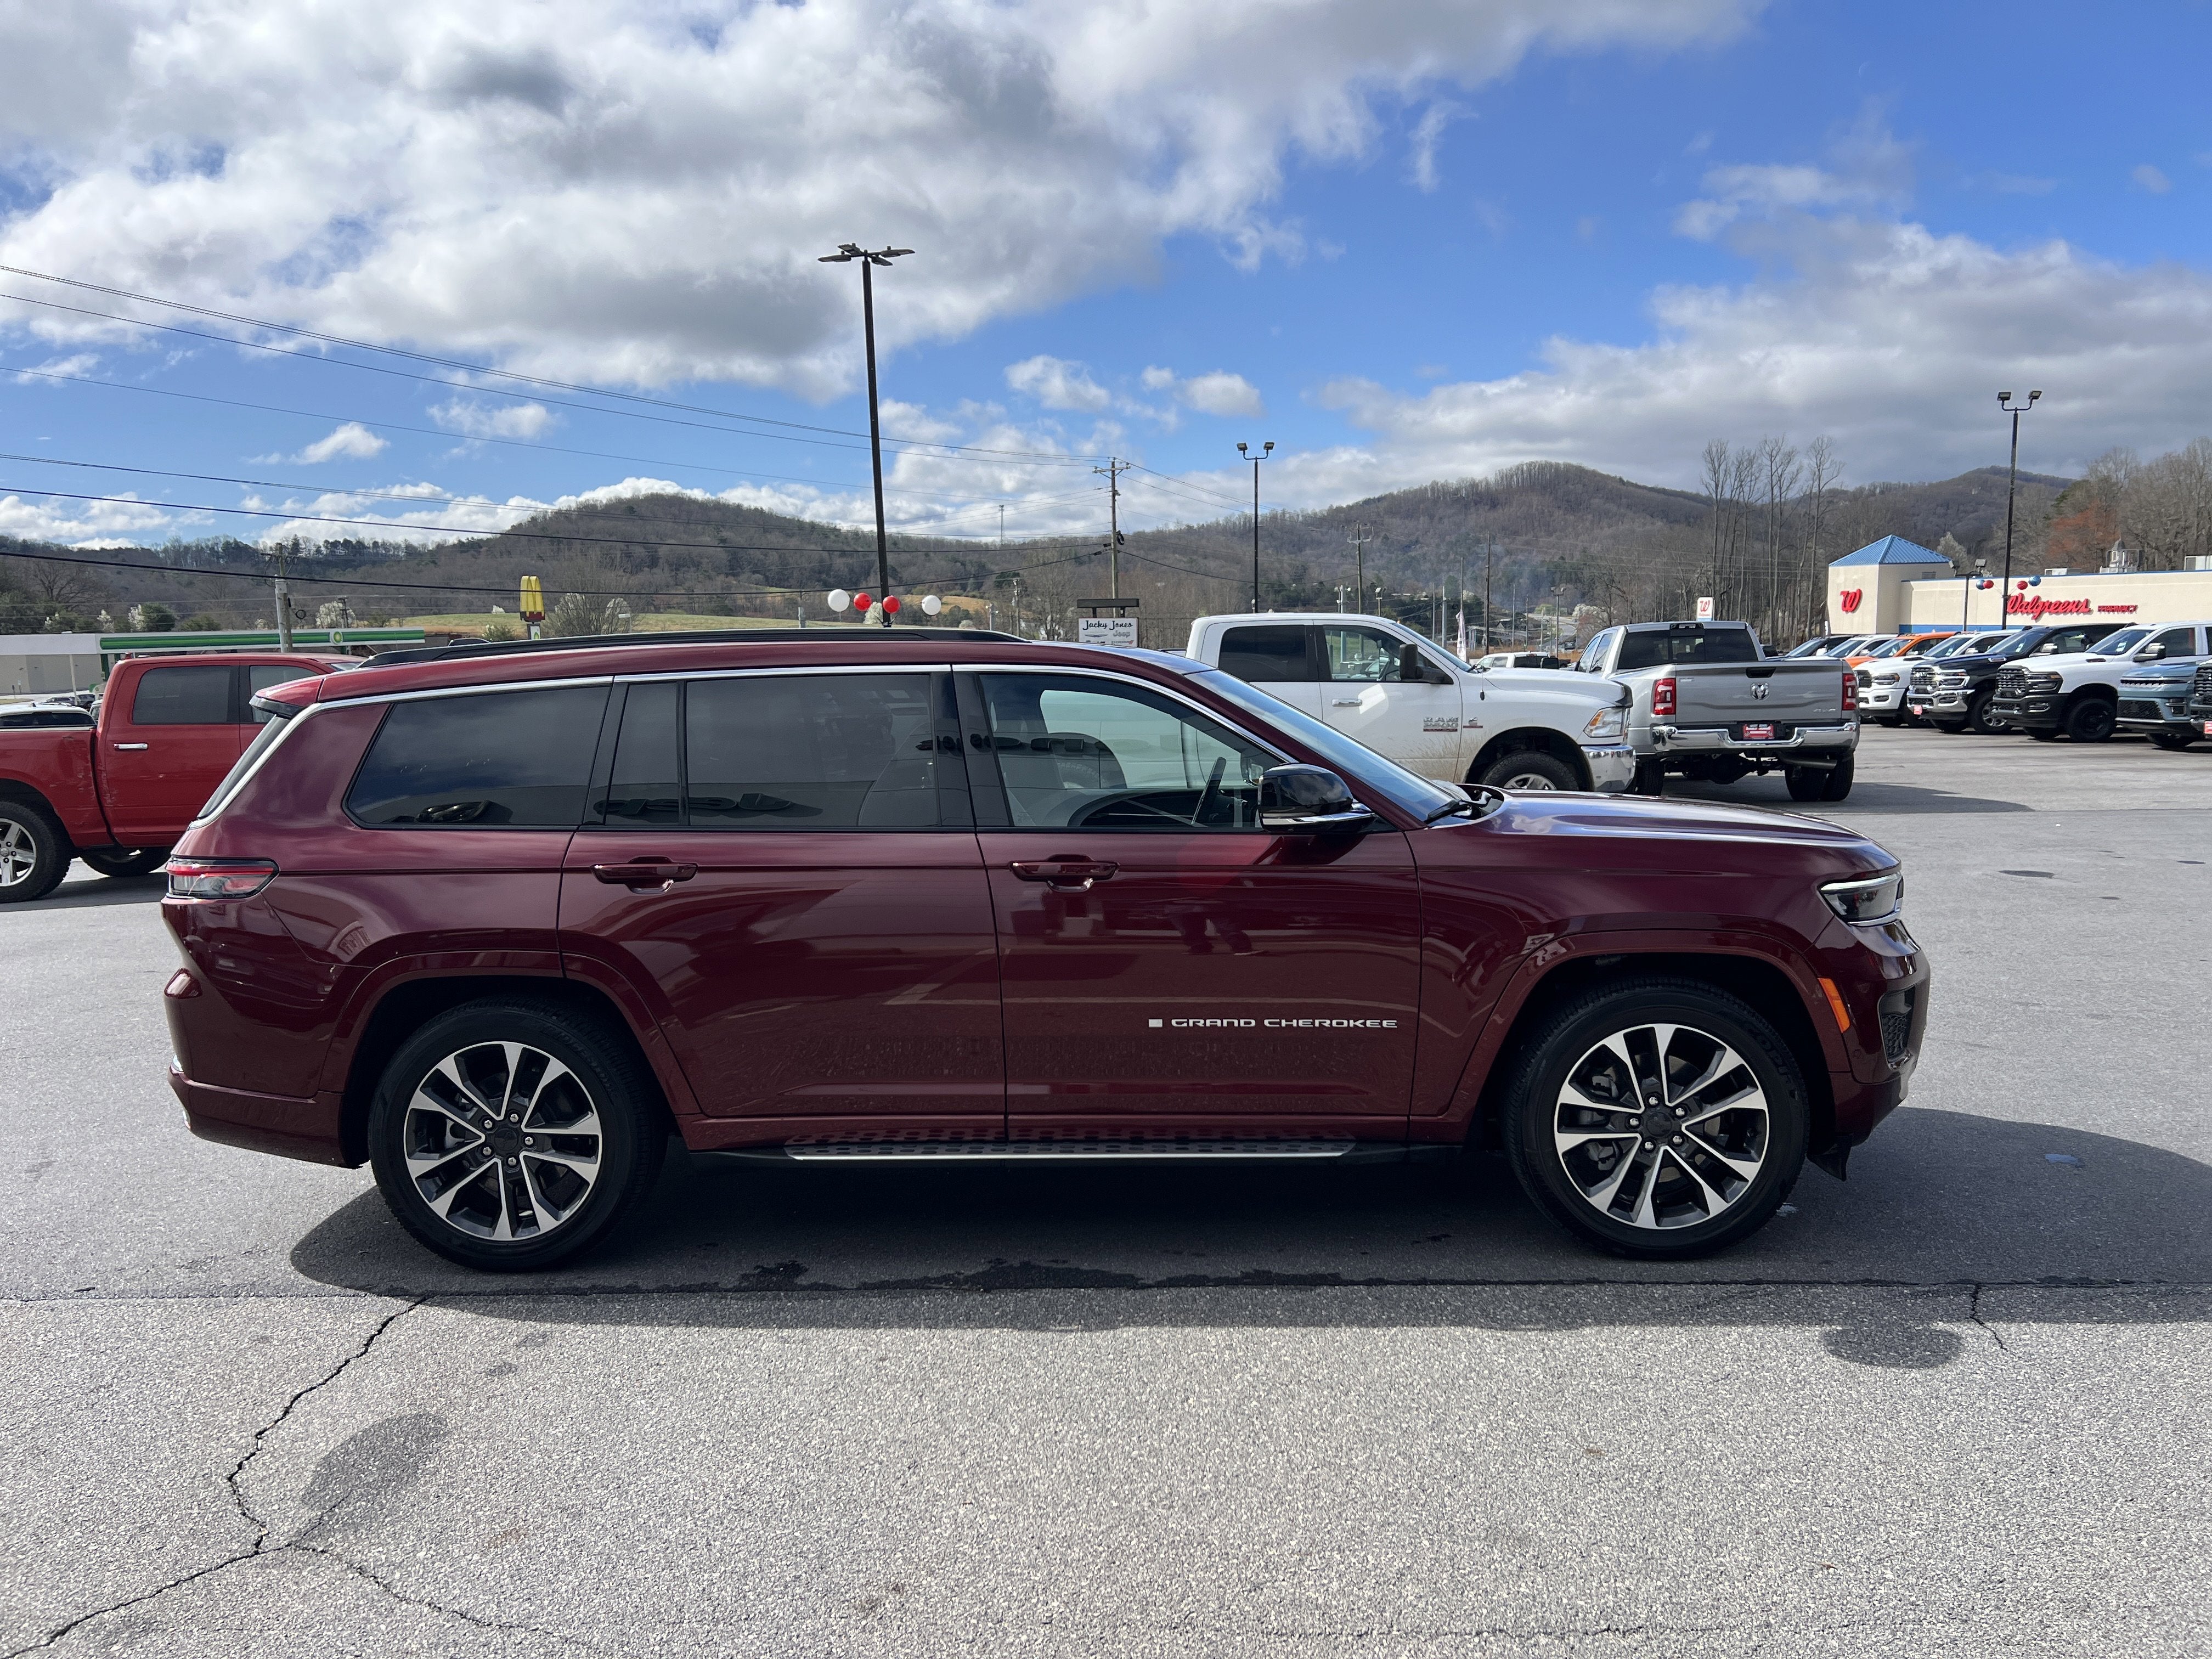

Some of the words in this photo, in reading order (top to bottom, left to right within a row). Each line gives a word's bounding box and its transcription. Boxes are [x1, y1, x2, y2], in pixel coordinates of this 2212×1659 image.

[2006, 592, 2091, 620] Walgreens
[1082, 620, 1108, 630] Jacky
[1109, 620, 1133, 630] Jones
[1171, 1018, 1256, 1028] GRAND
[1263, 1019, 1398, 1028] CHEROKEE
